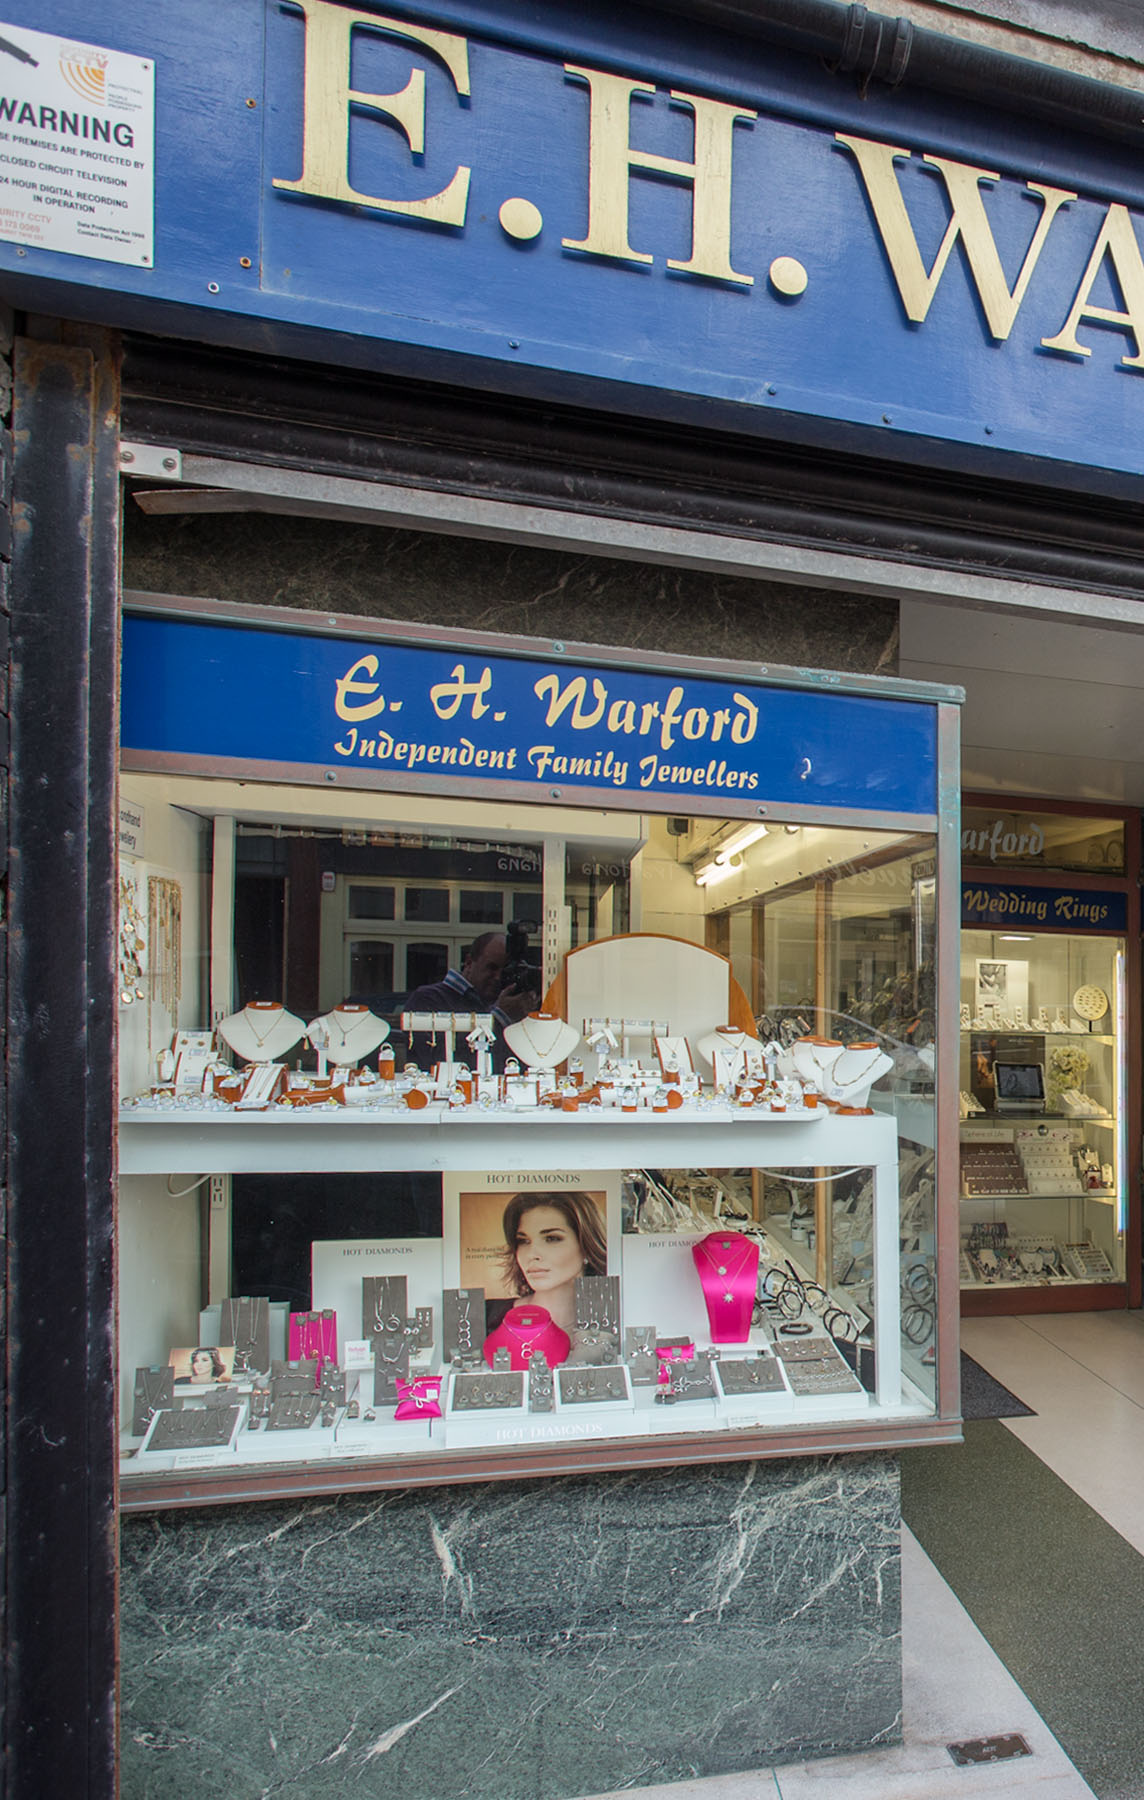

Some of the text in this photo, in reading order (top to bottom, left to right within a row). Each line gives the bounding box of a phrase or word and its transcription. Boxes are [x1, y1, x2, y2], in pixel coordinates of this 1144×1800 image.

[0, 97, 134, 148] WARNING
[12, 134, 58, 152] PREMISES
[60, 145, 78, 156] ARE
[79, 148, 132, 168] PROTECTED
[133, 160, 145, 170] BY
[0, 154, 128, 188] CLOSED CIRCUIT TELEVISION
[12, 177, 38, 190] HOUR
[40, 184, 74, 198] DIGITAL
[76, 191, 129, 209] RECORDING
[33, 194, 95, 214] IN OPERATION
[0, 207, 26, 218] URITY
[534, 673, 760, 750] Warford
[334, 727, 760, 791] Independent Family Jewellers
[961, 820, 1045, 863] arford
[963, 889, 1109, 924] Wedding Rings
[486, 1174, 581, 1184] HOT DIAMONDS
[342, 1246, 413, 1256] HOT DIAMONDS
[496, 1423, 603, 1441] HOT DIAMONDS
